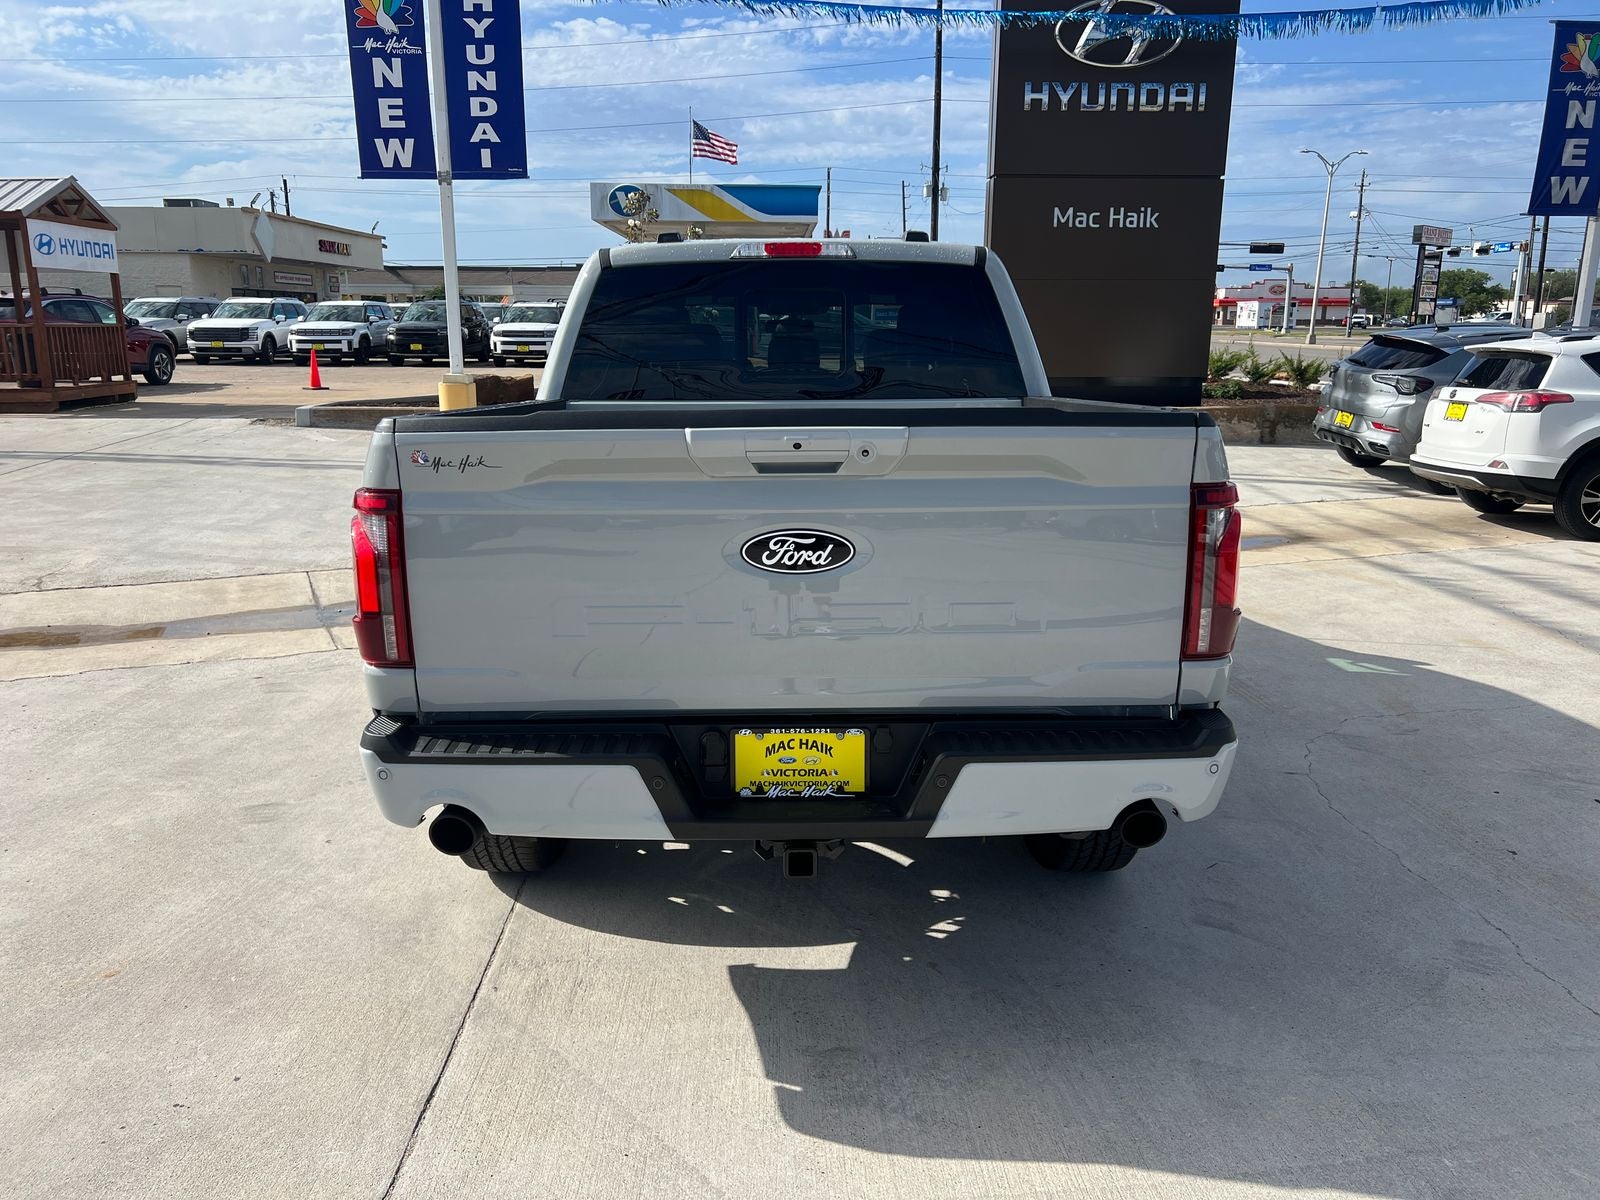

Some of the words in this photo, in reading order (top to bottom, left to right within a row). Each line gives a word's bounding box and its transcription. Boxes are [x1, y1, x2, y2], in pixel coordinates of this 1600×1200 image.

[352, 37, 384, 53] Mac
[385, 36, 422, 54] Haik
[463, 0, 502, 168] HYUNDAI
[1552, 81, 1584, 97] Mac
[1023, 81, 1208, 112] HYUNDAI
[371, 57, 415, 168] NEW
[1550, 99, 1597, 205] NEW
[1053, 207, 1101, 228] Mac
[1108, 206, 1160, 229] Haik
[58, 237, 115, 260] HYUNDAI
[415, 456, 457, 473] Mac
[458, 454, 503, 473] Haik
[761, 536, 834, 566] Ford
[765, 738, 795, 758] MAC
[799, 738, 834, 758] HAIK
[770, 768, 829, 777] VICTORIA
[800, 785, 855, 798] Haik
